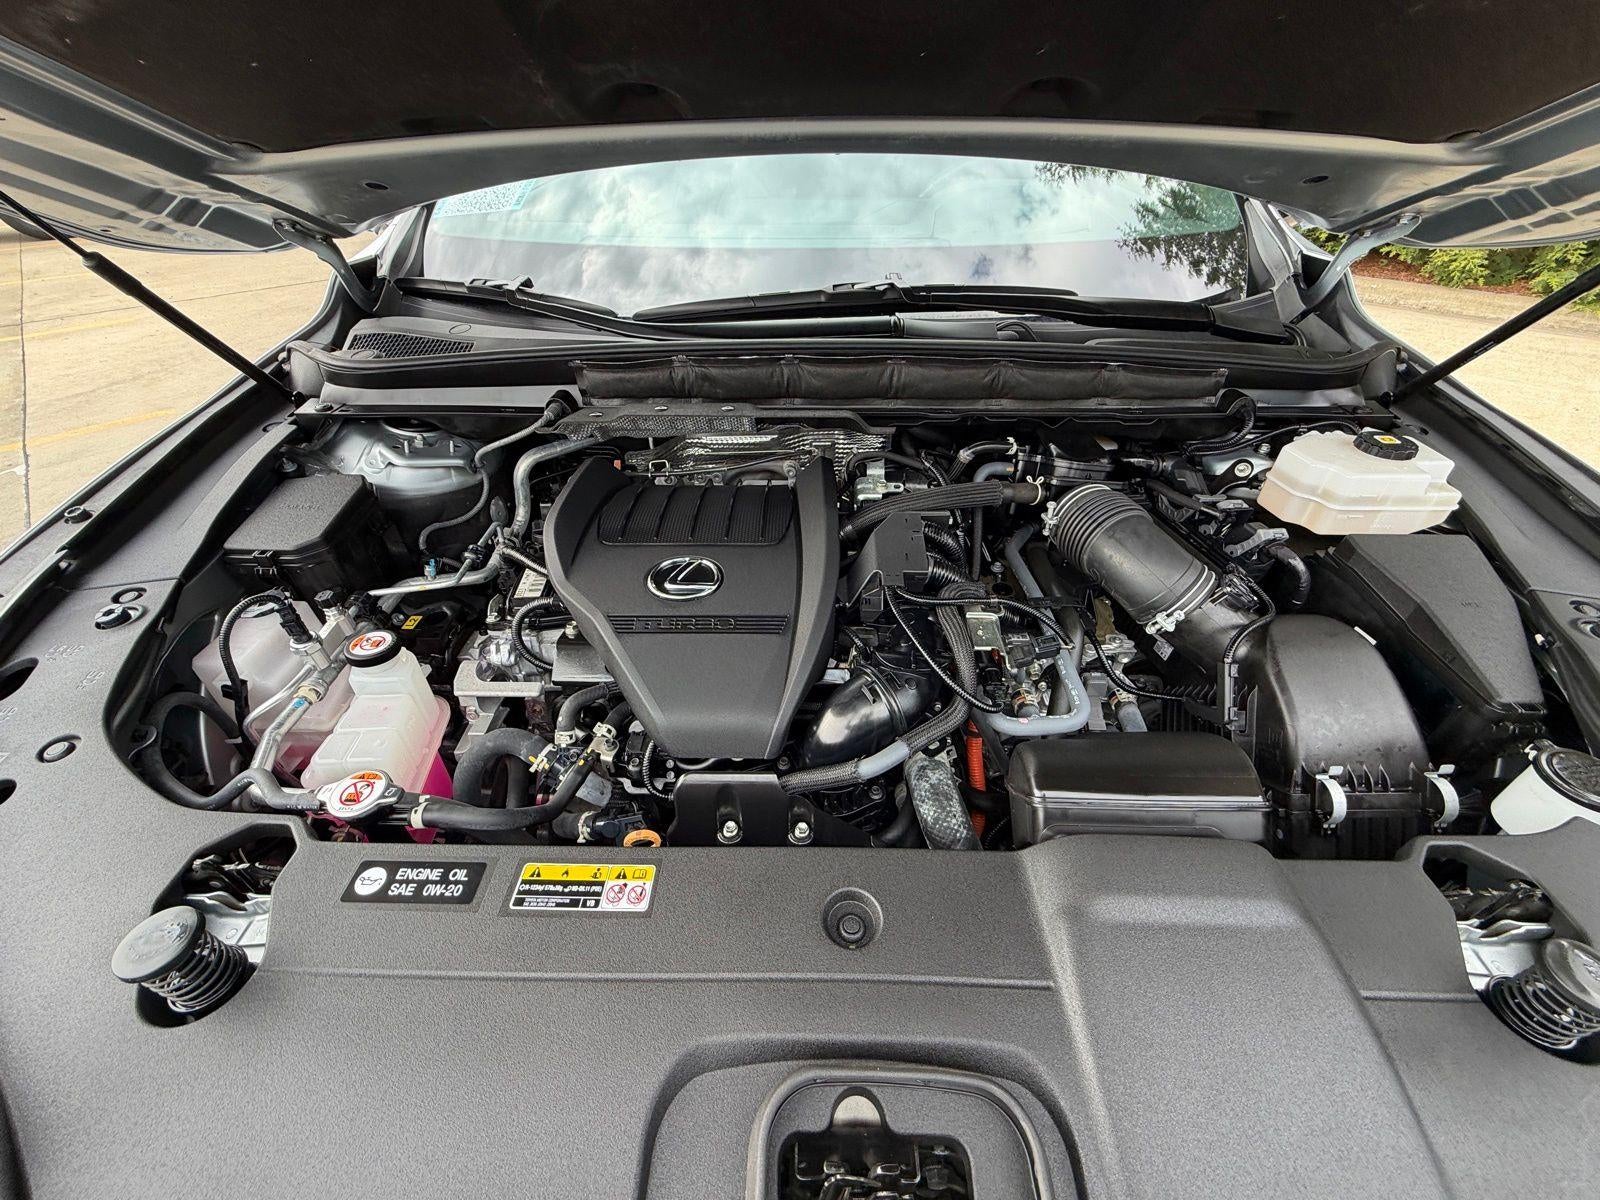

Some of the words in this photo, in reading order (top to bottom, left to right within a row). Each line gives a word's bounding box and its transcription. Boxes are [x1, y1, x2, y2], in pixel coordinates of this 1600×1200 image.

[636, 617, 735, 630] TURBO
[395, 868, 443, 880] ENGINE
[448, 868, 469, 881] OIL
[388, 883, 417, 896] SAE
[422, 884, 464, 897] 0W-20
